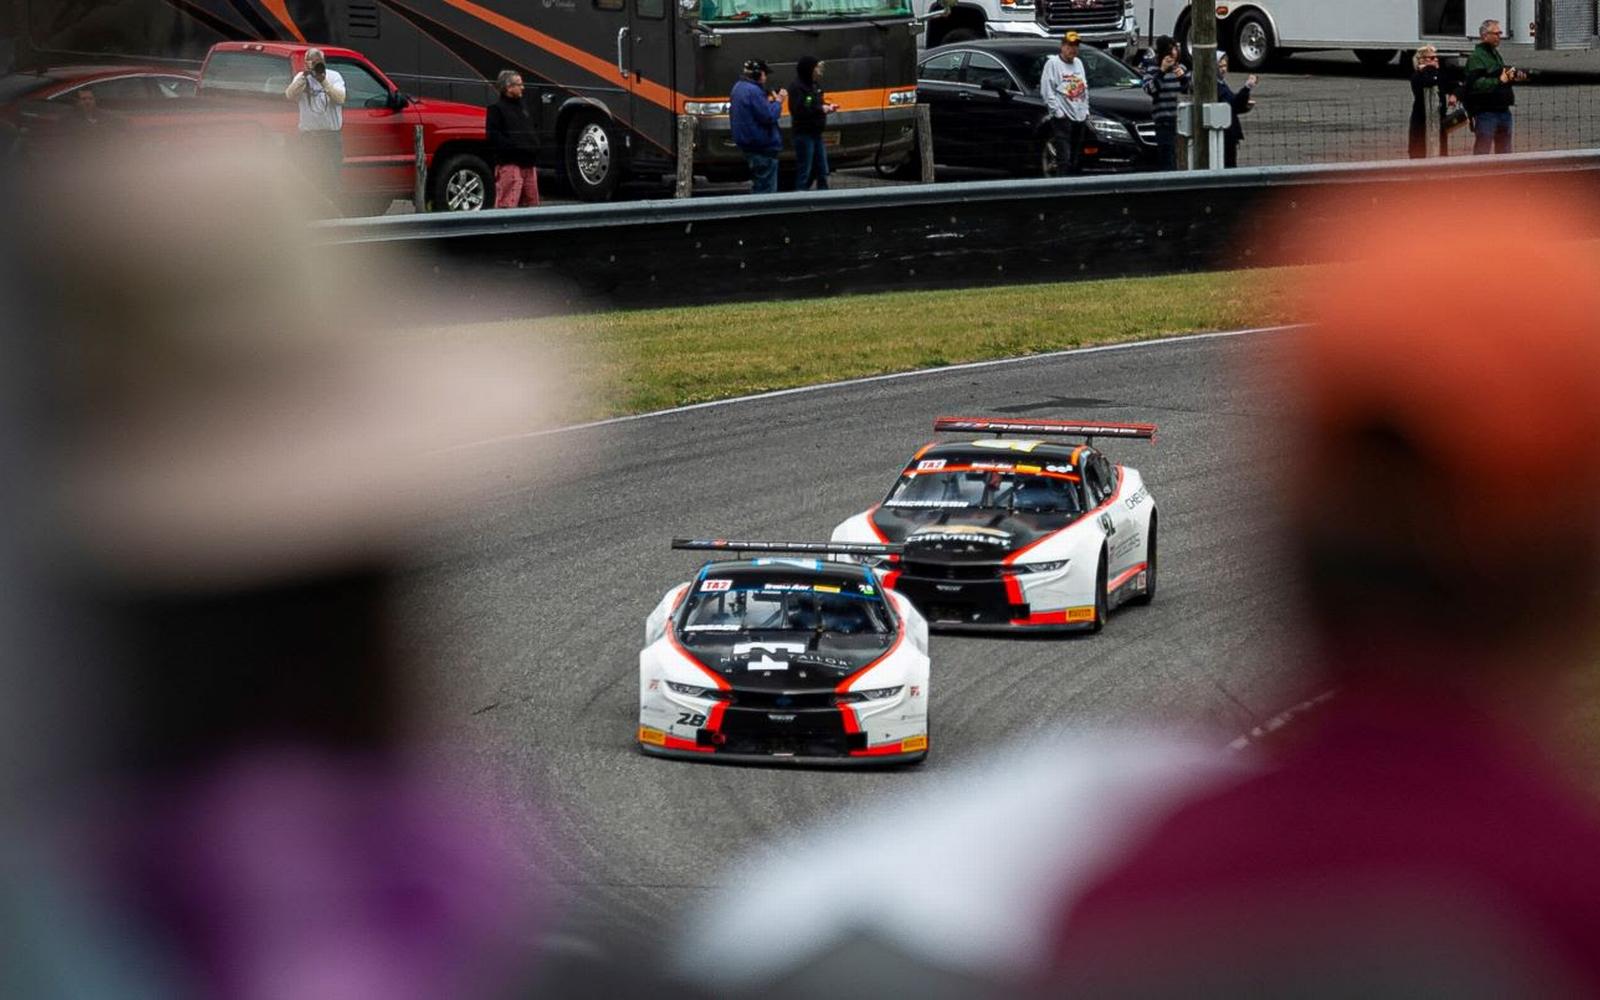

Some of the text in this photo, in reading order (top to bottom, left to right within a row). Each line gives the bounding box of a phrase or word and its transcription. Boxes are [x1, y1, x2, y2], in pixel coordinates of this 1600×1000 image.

[906, 533, 1012, 548] CHEVROLET
[705, 581, 729, 590] TA2
[676, 712, 706, 727] 28
